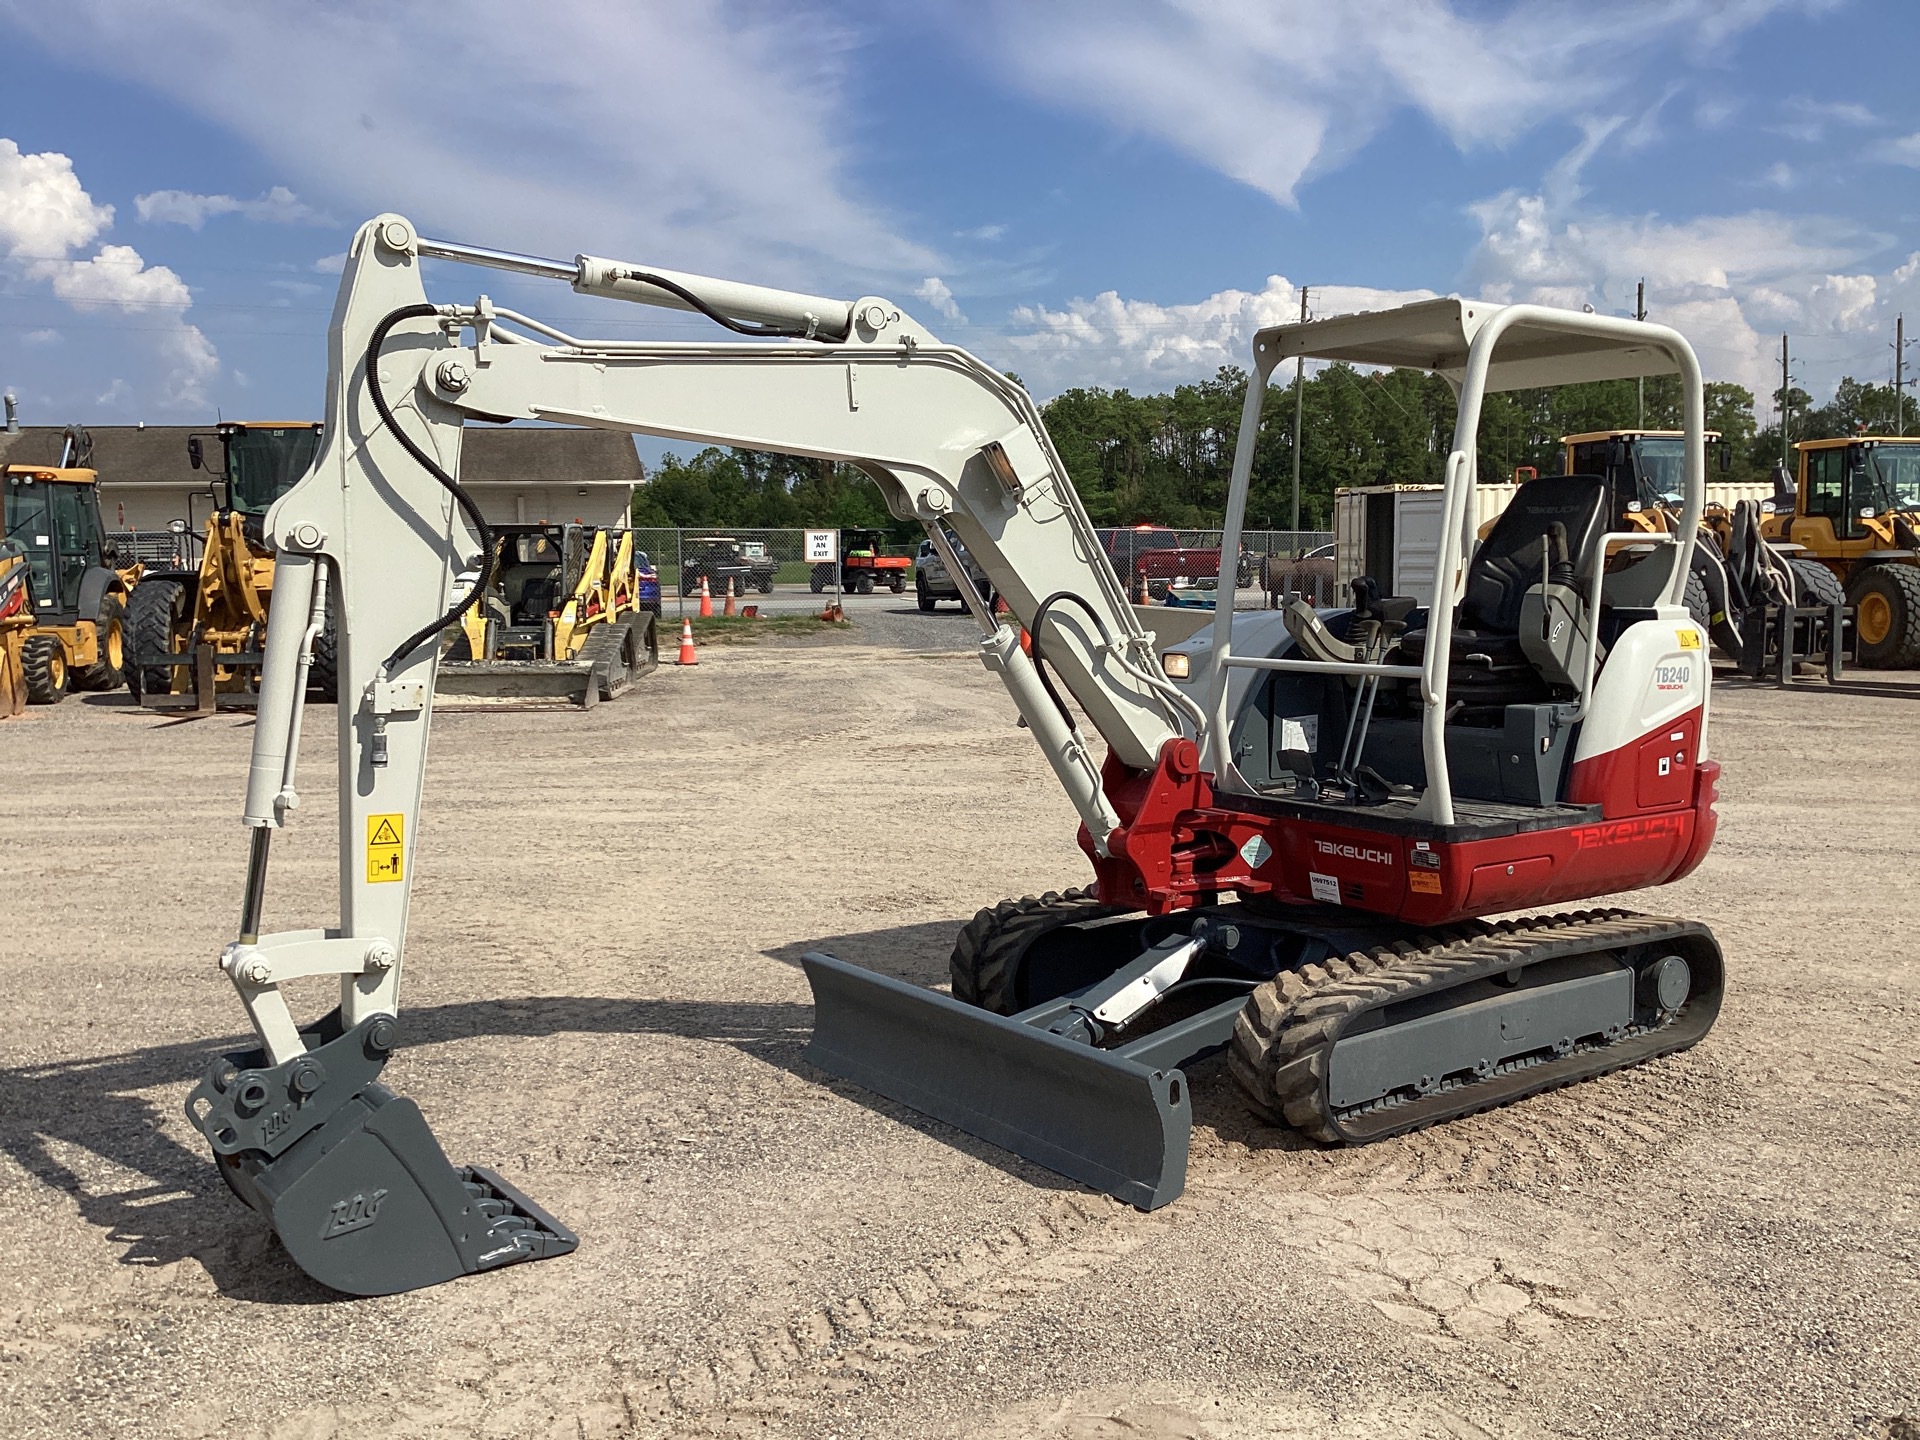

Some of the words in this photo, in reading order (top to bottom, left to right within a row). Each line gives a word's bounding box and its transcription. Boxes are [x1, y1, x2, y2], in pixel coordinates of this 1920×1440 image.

[1526, 505, 1581, 514] TAKEUCHI
[1655, 666, 1690, 683] TB240
[1571, 815, 1685, 849] TAKEUCHI
[1314, 840, 1393, 865] TAKEUCHI
